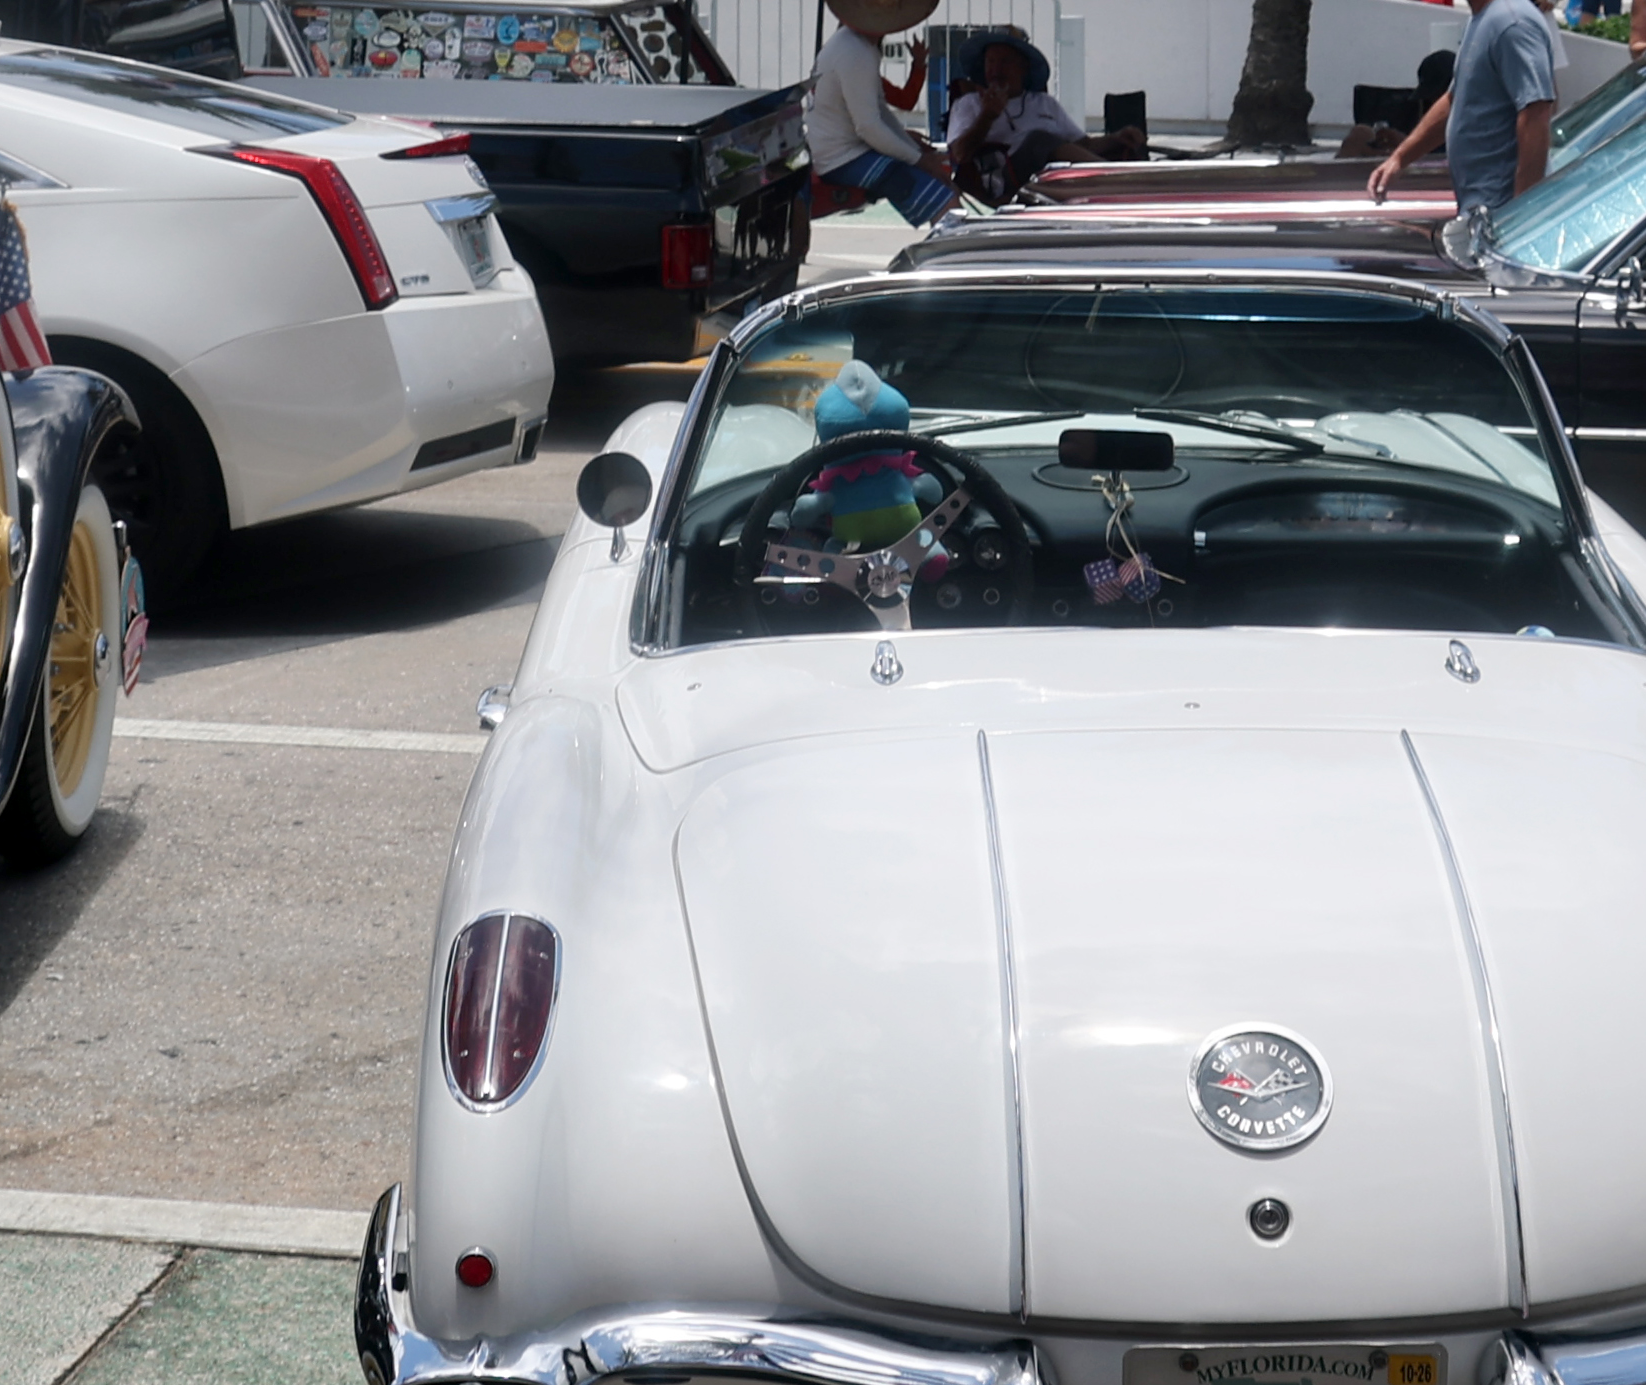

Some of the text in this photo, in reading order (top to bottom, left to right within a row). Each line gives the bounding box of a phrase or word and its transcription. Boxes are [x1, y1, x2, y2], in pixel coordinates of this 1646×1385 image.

[1211, 1041, 1307, 1075] CHEVROLET
[1216, 1105, 1306, 1135] CORVETTE
[1196, 1353, 1375, 1384] MYFLORIDA.COM
[1400, 1363, 1432, 1384] 10-26
